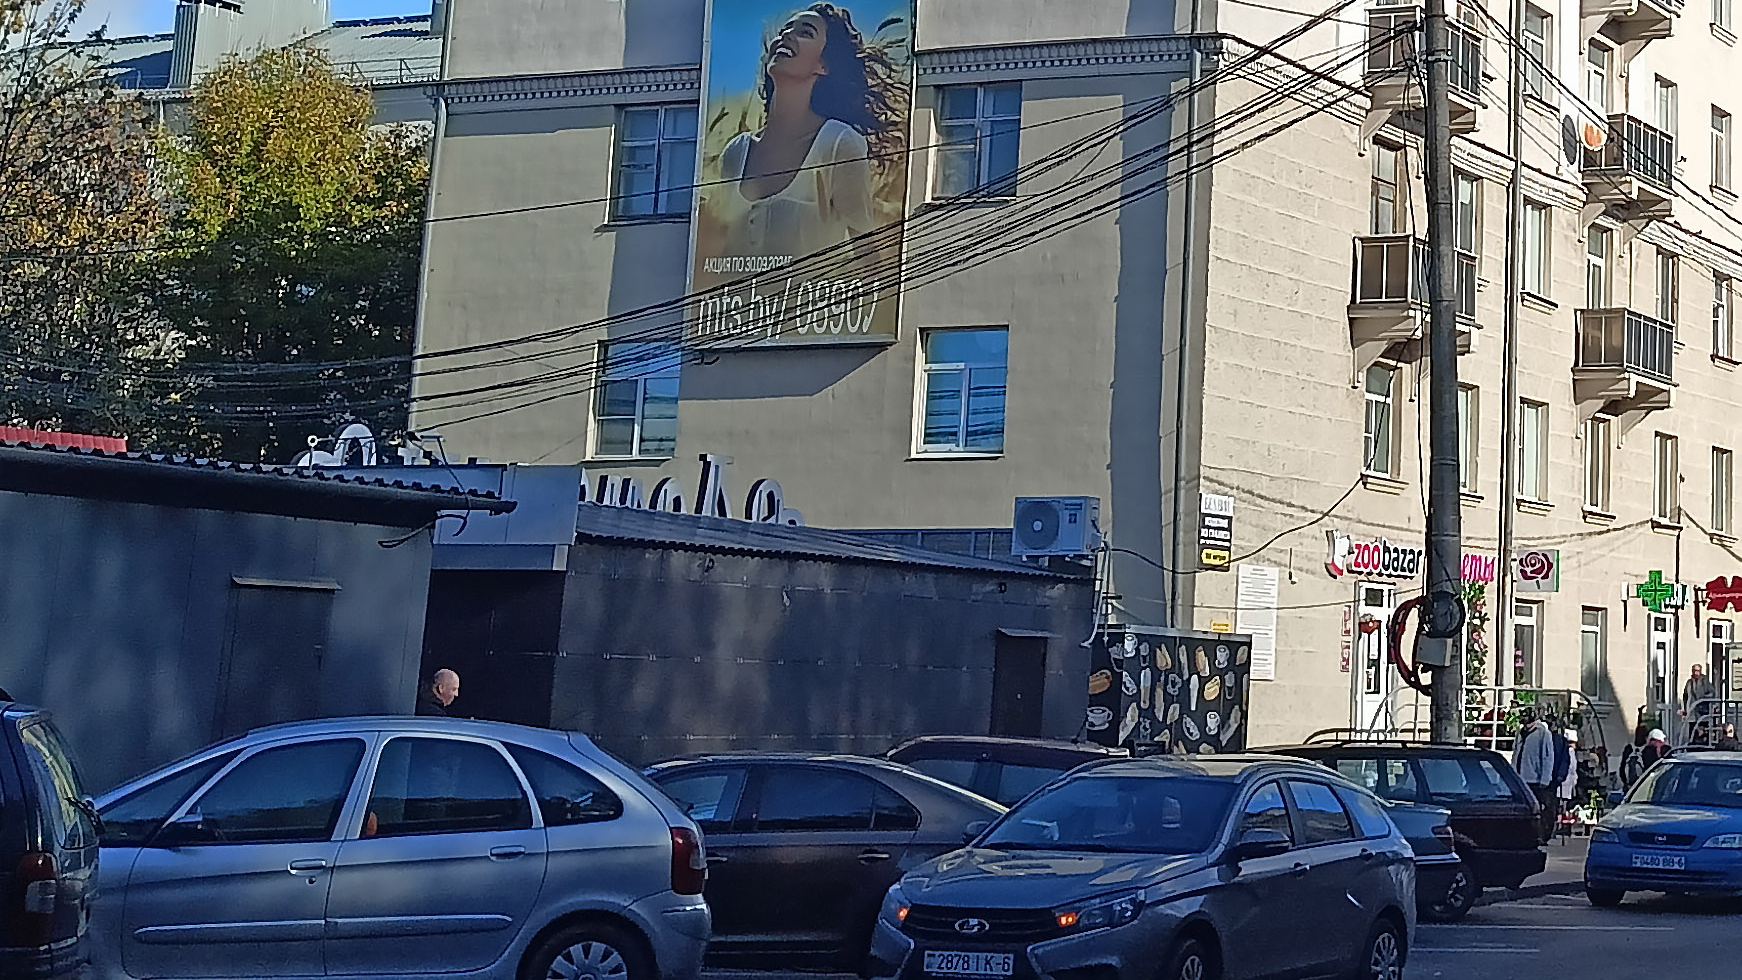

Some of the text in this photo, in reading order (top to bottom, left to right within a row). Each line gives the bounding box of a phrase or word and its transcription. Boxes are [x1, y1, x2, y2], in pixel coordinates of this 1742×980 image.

[704, 257, 730, 274] АКЦИЯ
[731, 257, 744, 272] ПО
[1353, 539, 1423, 574] zoobazar
[937, 953, 970, 971] 2878
